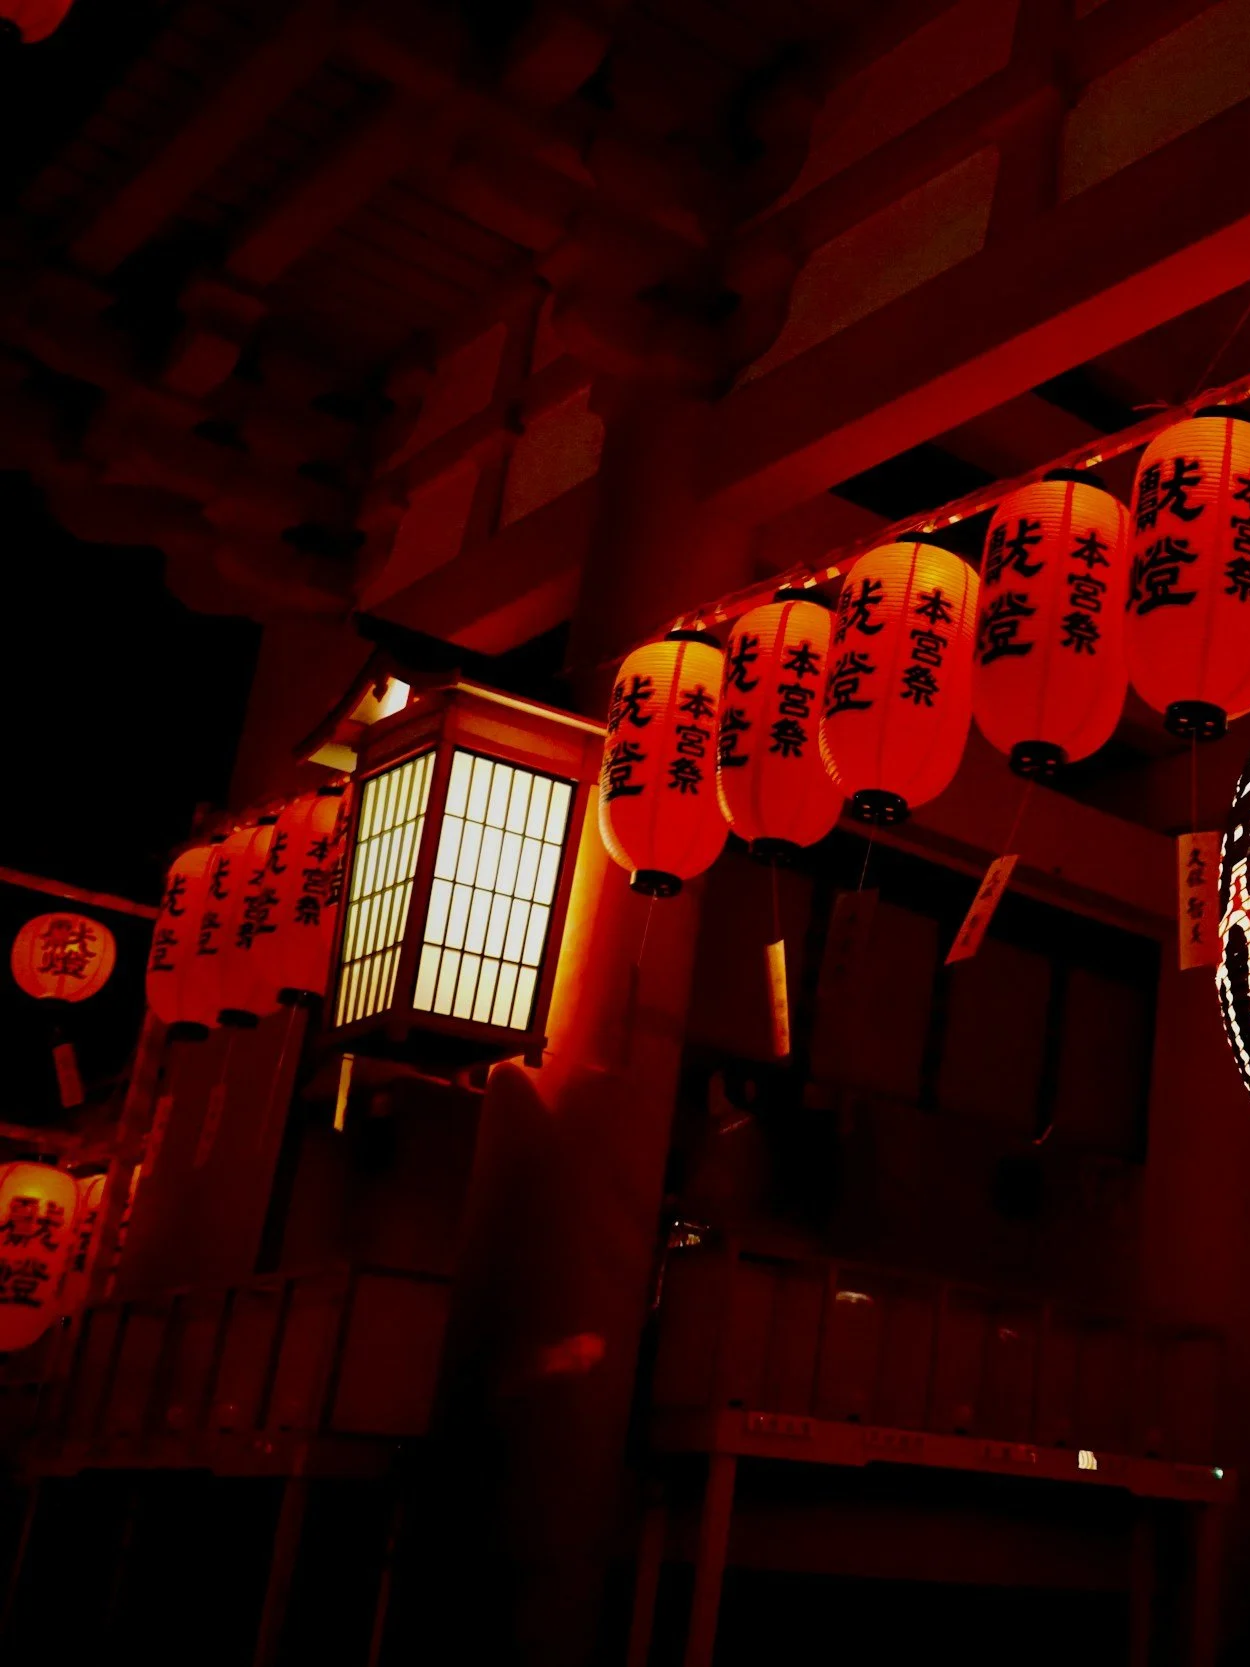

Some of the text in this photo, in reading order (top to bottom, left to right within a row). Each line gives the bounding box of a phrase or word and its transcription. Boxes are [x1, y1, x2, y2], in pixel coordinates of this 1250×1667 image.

[900, 587, 953, 708] 本宮祭
[1060, 530, 1111, 656] 本宮祭
[667, 688, 715, 795] 本宮祭
[769, 641, 821, 758] 本宮祭
